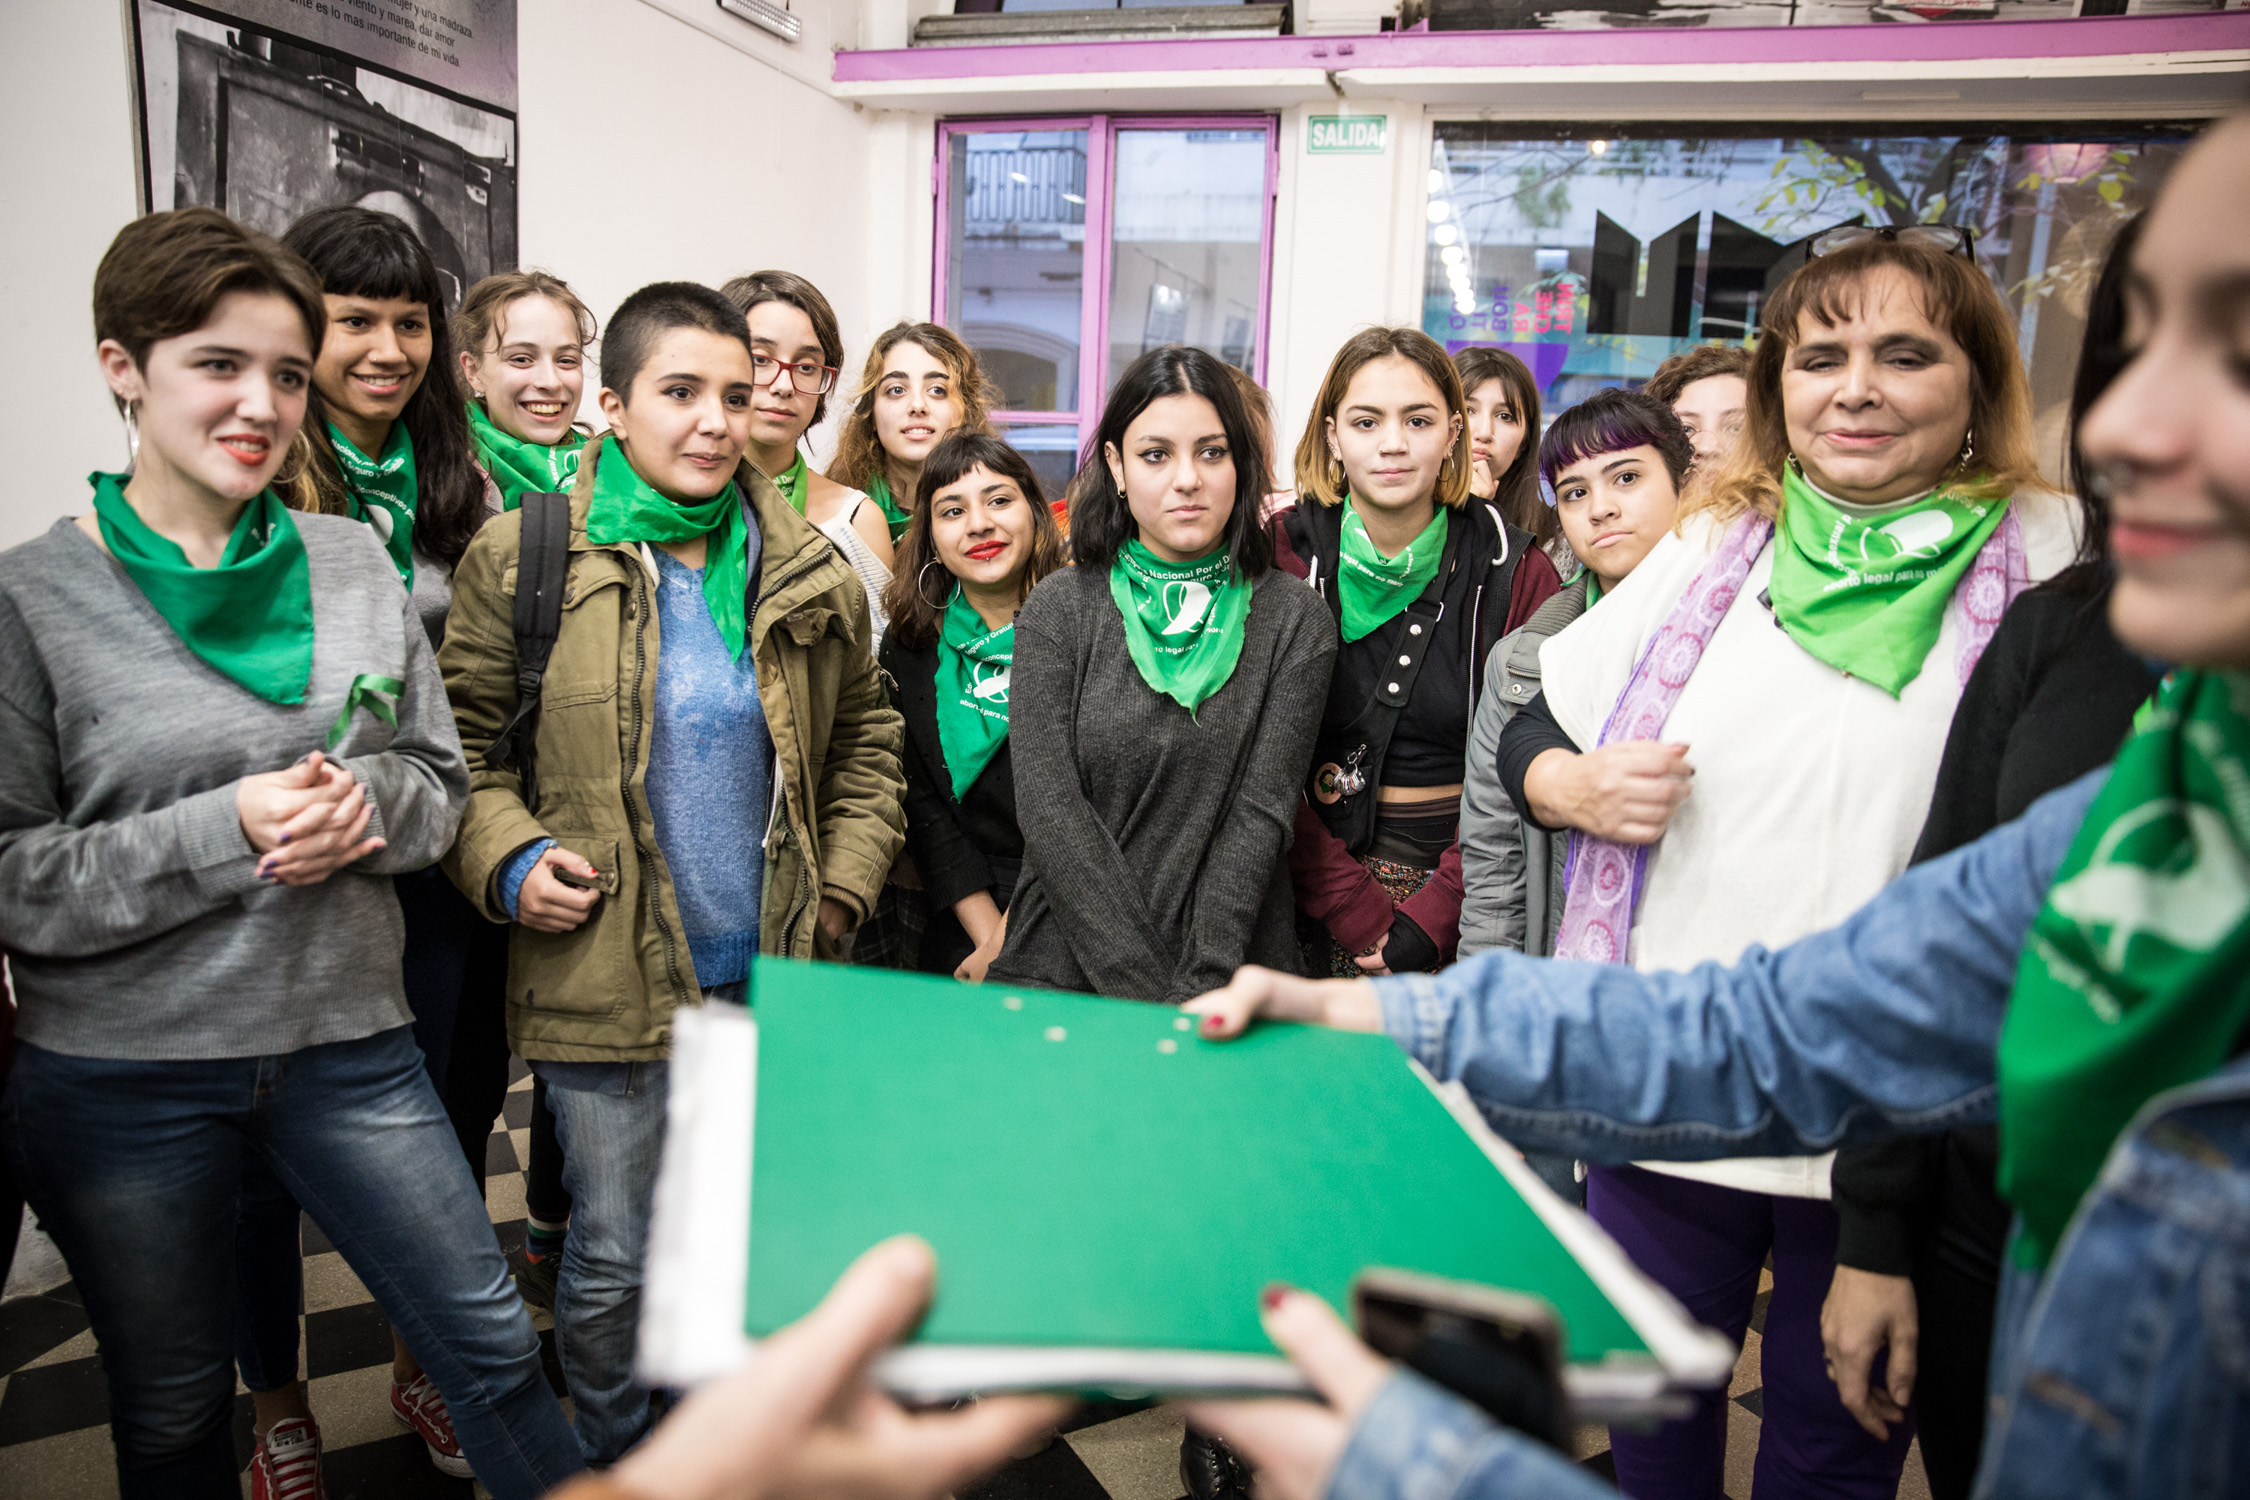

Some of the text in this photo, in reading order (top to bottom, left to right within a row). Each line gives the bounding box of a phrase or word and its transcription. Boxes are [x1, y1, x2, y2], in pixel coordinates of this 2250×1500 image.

[414, 5, 419, 16] y
[421, 8, 437, 22] una
[316, 2, 328, 15] es
[331, 4, 341, 19] lo
[344, 13, 364, 28] mas
[367, 19, 416, 48] importante
[418, 41, 429, 54] de
[431, 47, 441, 58] mi
[379, 8, 384, 20] y
[388, 12, 416, 33] marea,
[419, 23, 432, 37] dar
[435, 31, 455, 47] amor
[1312, 122, 1379, 147] SALIDA
[1149, 569, 1194, 580] Nacional
[1195, 566, 1213, 576] Por
[1215, 560, 1222, 570] el
[1357, 563, 1375, 577] para
[1864, 571, 1894, 585] legal
[1895, 569, 1913, 583] para
[1165, 646, 1184, 655] legal
[983, 709, 1001, 719] para
